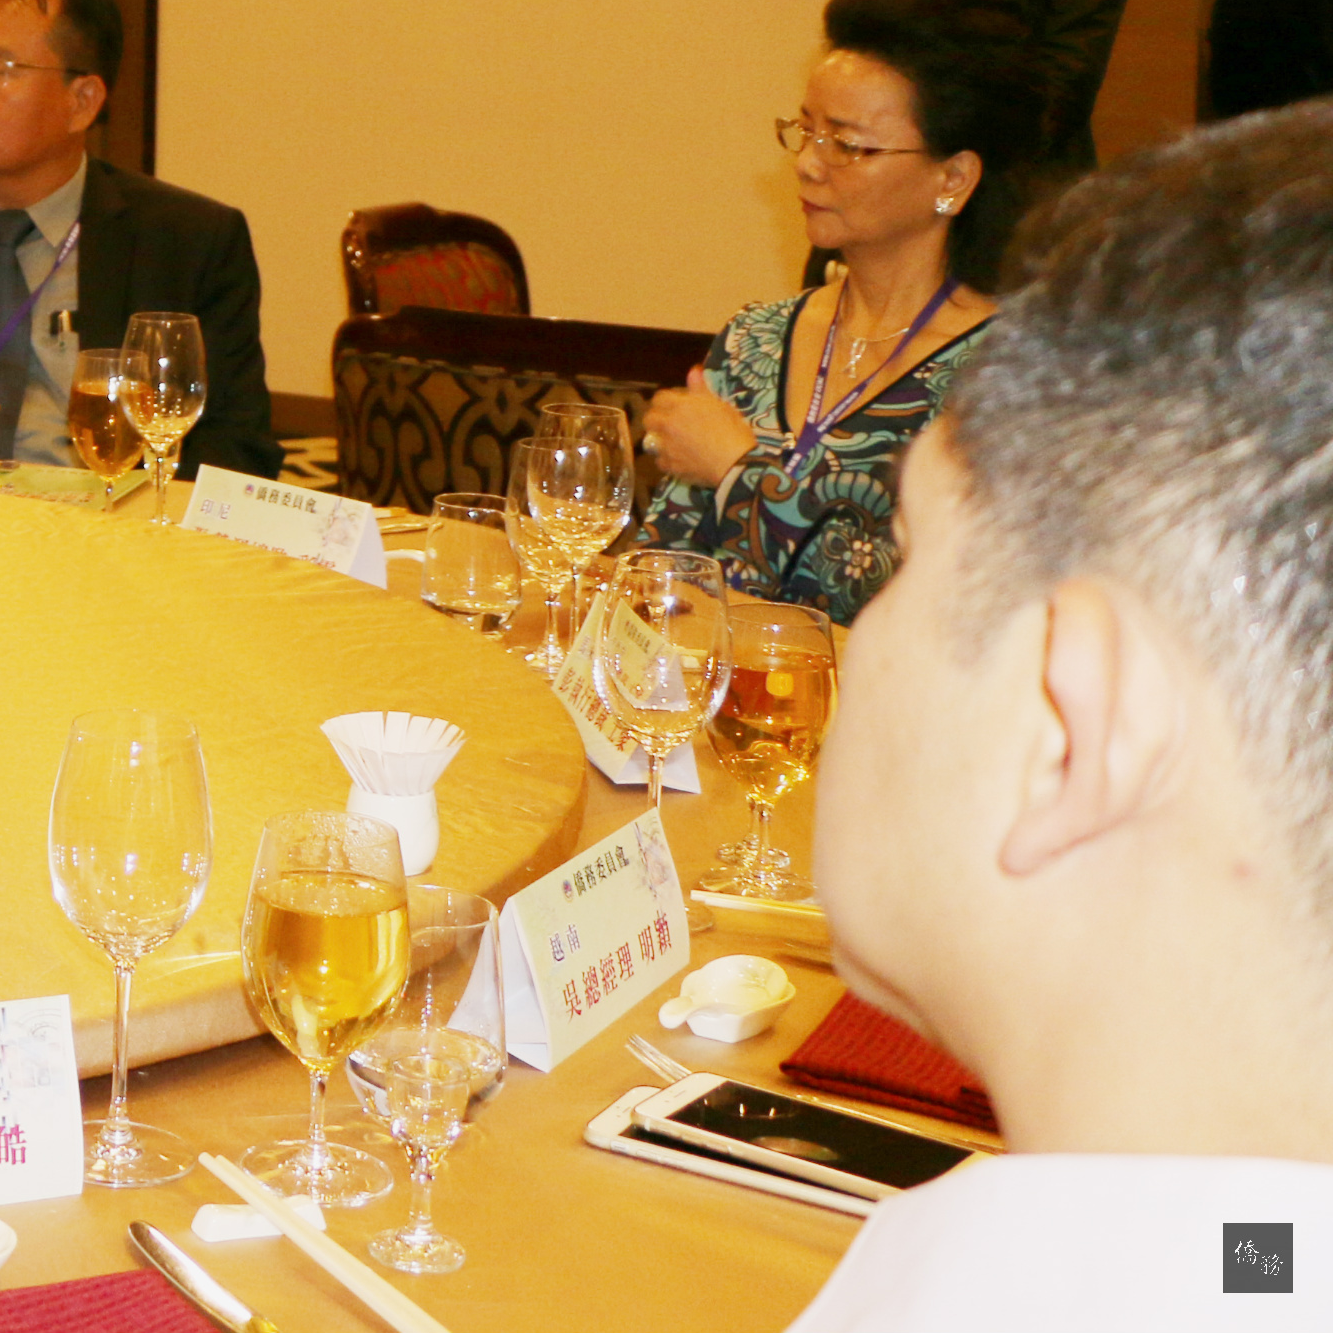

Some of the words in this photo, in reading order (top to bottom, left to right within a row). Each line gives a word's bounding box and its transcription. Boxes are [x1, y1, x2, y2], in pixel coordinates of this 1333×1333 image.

[573, 845, 628, 897] 僑務委員會
[549, 924, 581, 961] 越南
